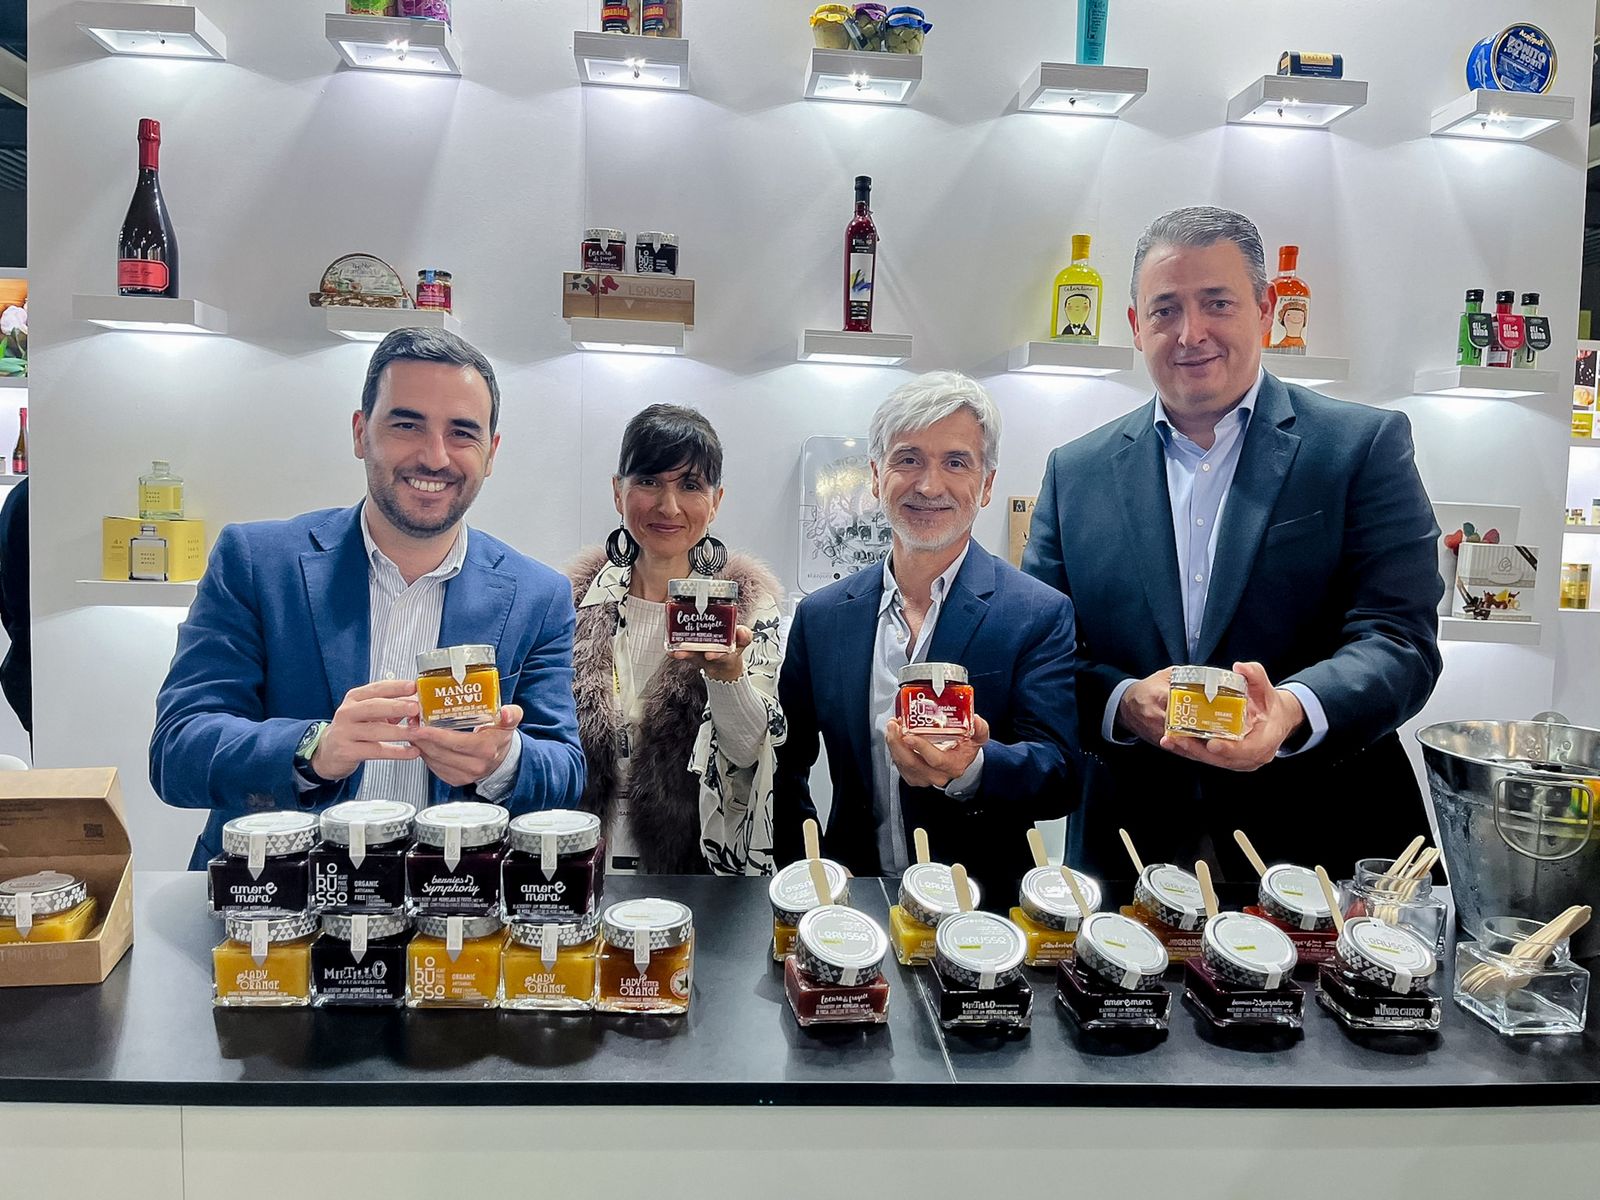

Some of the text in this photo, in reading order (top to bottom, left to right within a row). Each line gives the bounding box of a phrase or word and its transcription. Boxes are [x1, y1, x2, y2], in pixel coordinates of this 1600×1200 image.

[677, 610, 718, 625] locura
[685, 620, 724, 631] di fragole
[435, 682, 482, 698] MANGO
[444, 697, 454, 706] &
[316, 863, 338, 877] LO
[230, 882, 278, 895] amore
[354, 880, 379, 888] ORGANIC
[520, 881, 567, 894] amore
[235, 895, 273, 903] mora
[316, 892, 348, 907] SSO
[525, 893, 561, 902] mora
[953, 936, 1007, 945] LORUSSO
[414, 956, 436, 971] LO
[243, 969, 269, 981] LADY
[532, 973, 557, 984] LADY
[240, 980, 280, 990] ORANGE
[527, 983, 566, 993] ORANGE
[620, 977, 642, 988] LADY
[414, 984, 446, 999] SSO
[620, 987, 660, 997] ORANGE
[1400, 1007, 1425, 1017] CHERRY
